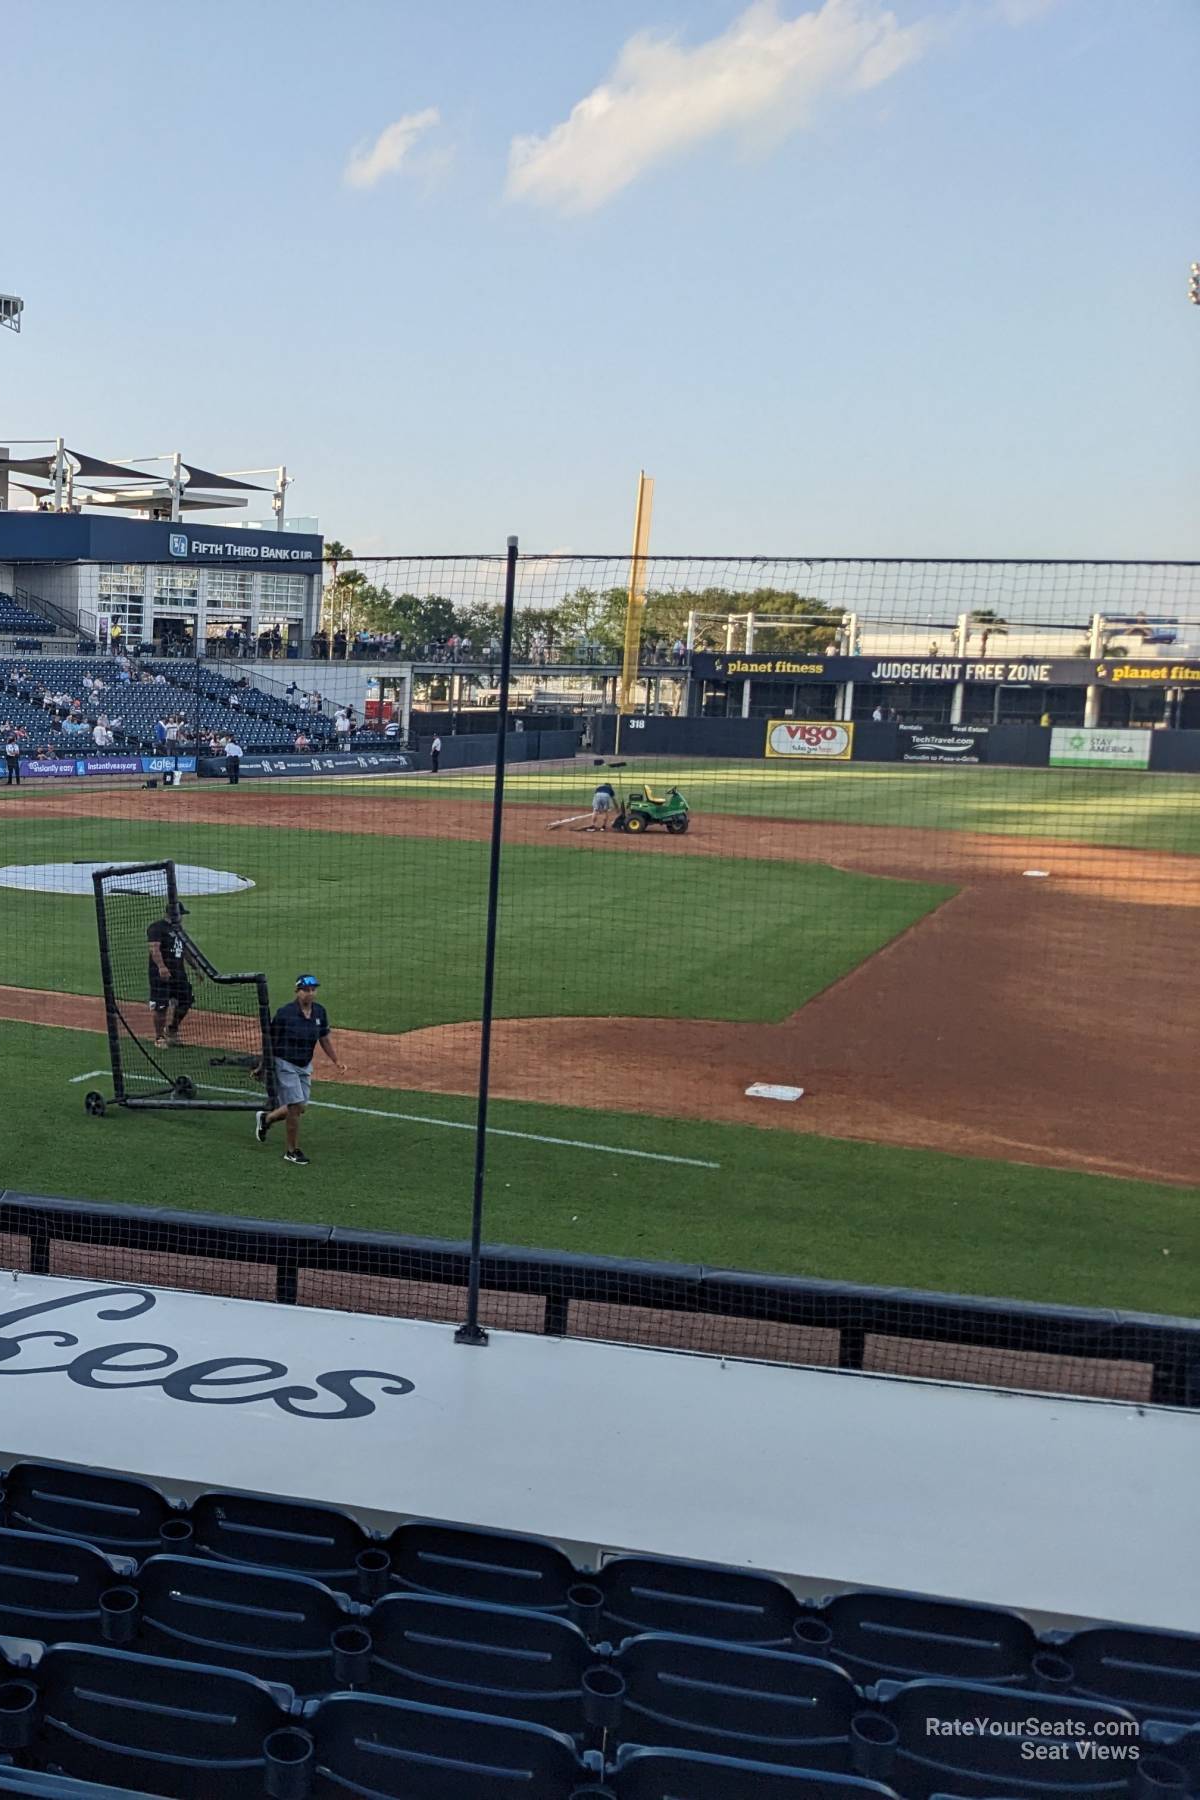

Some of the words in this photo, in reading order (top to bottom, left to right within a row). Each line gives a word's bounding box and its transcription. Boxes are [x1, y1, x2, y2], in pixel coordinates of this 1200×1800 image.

[191, 541, 223, 555] FIFTH
[225, 543, 259, 557] THIRD
[261, 546, 290, 559] BANK
[727, 660, 772, 675] planet
[775, 660, 824, 674] fitness
[872, 662, 962, 680] JUDGEMENT
[965, 664, 1004, 681] FREE
[1007, 665, 1051, 682] ZONE
[1112, 665, 1169, 682] planet
[629, 720, 645, 729] 318
[911, 735, 975, 745] TechTravel.com
[1090, 737, 1113, 746] STAY
[59, 764, 74, 774] easy
